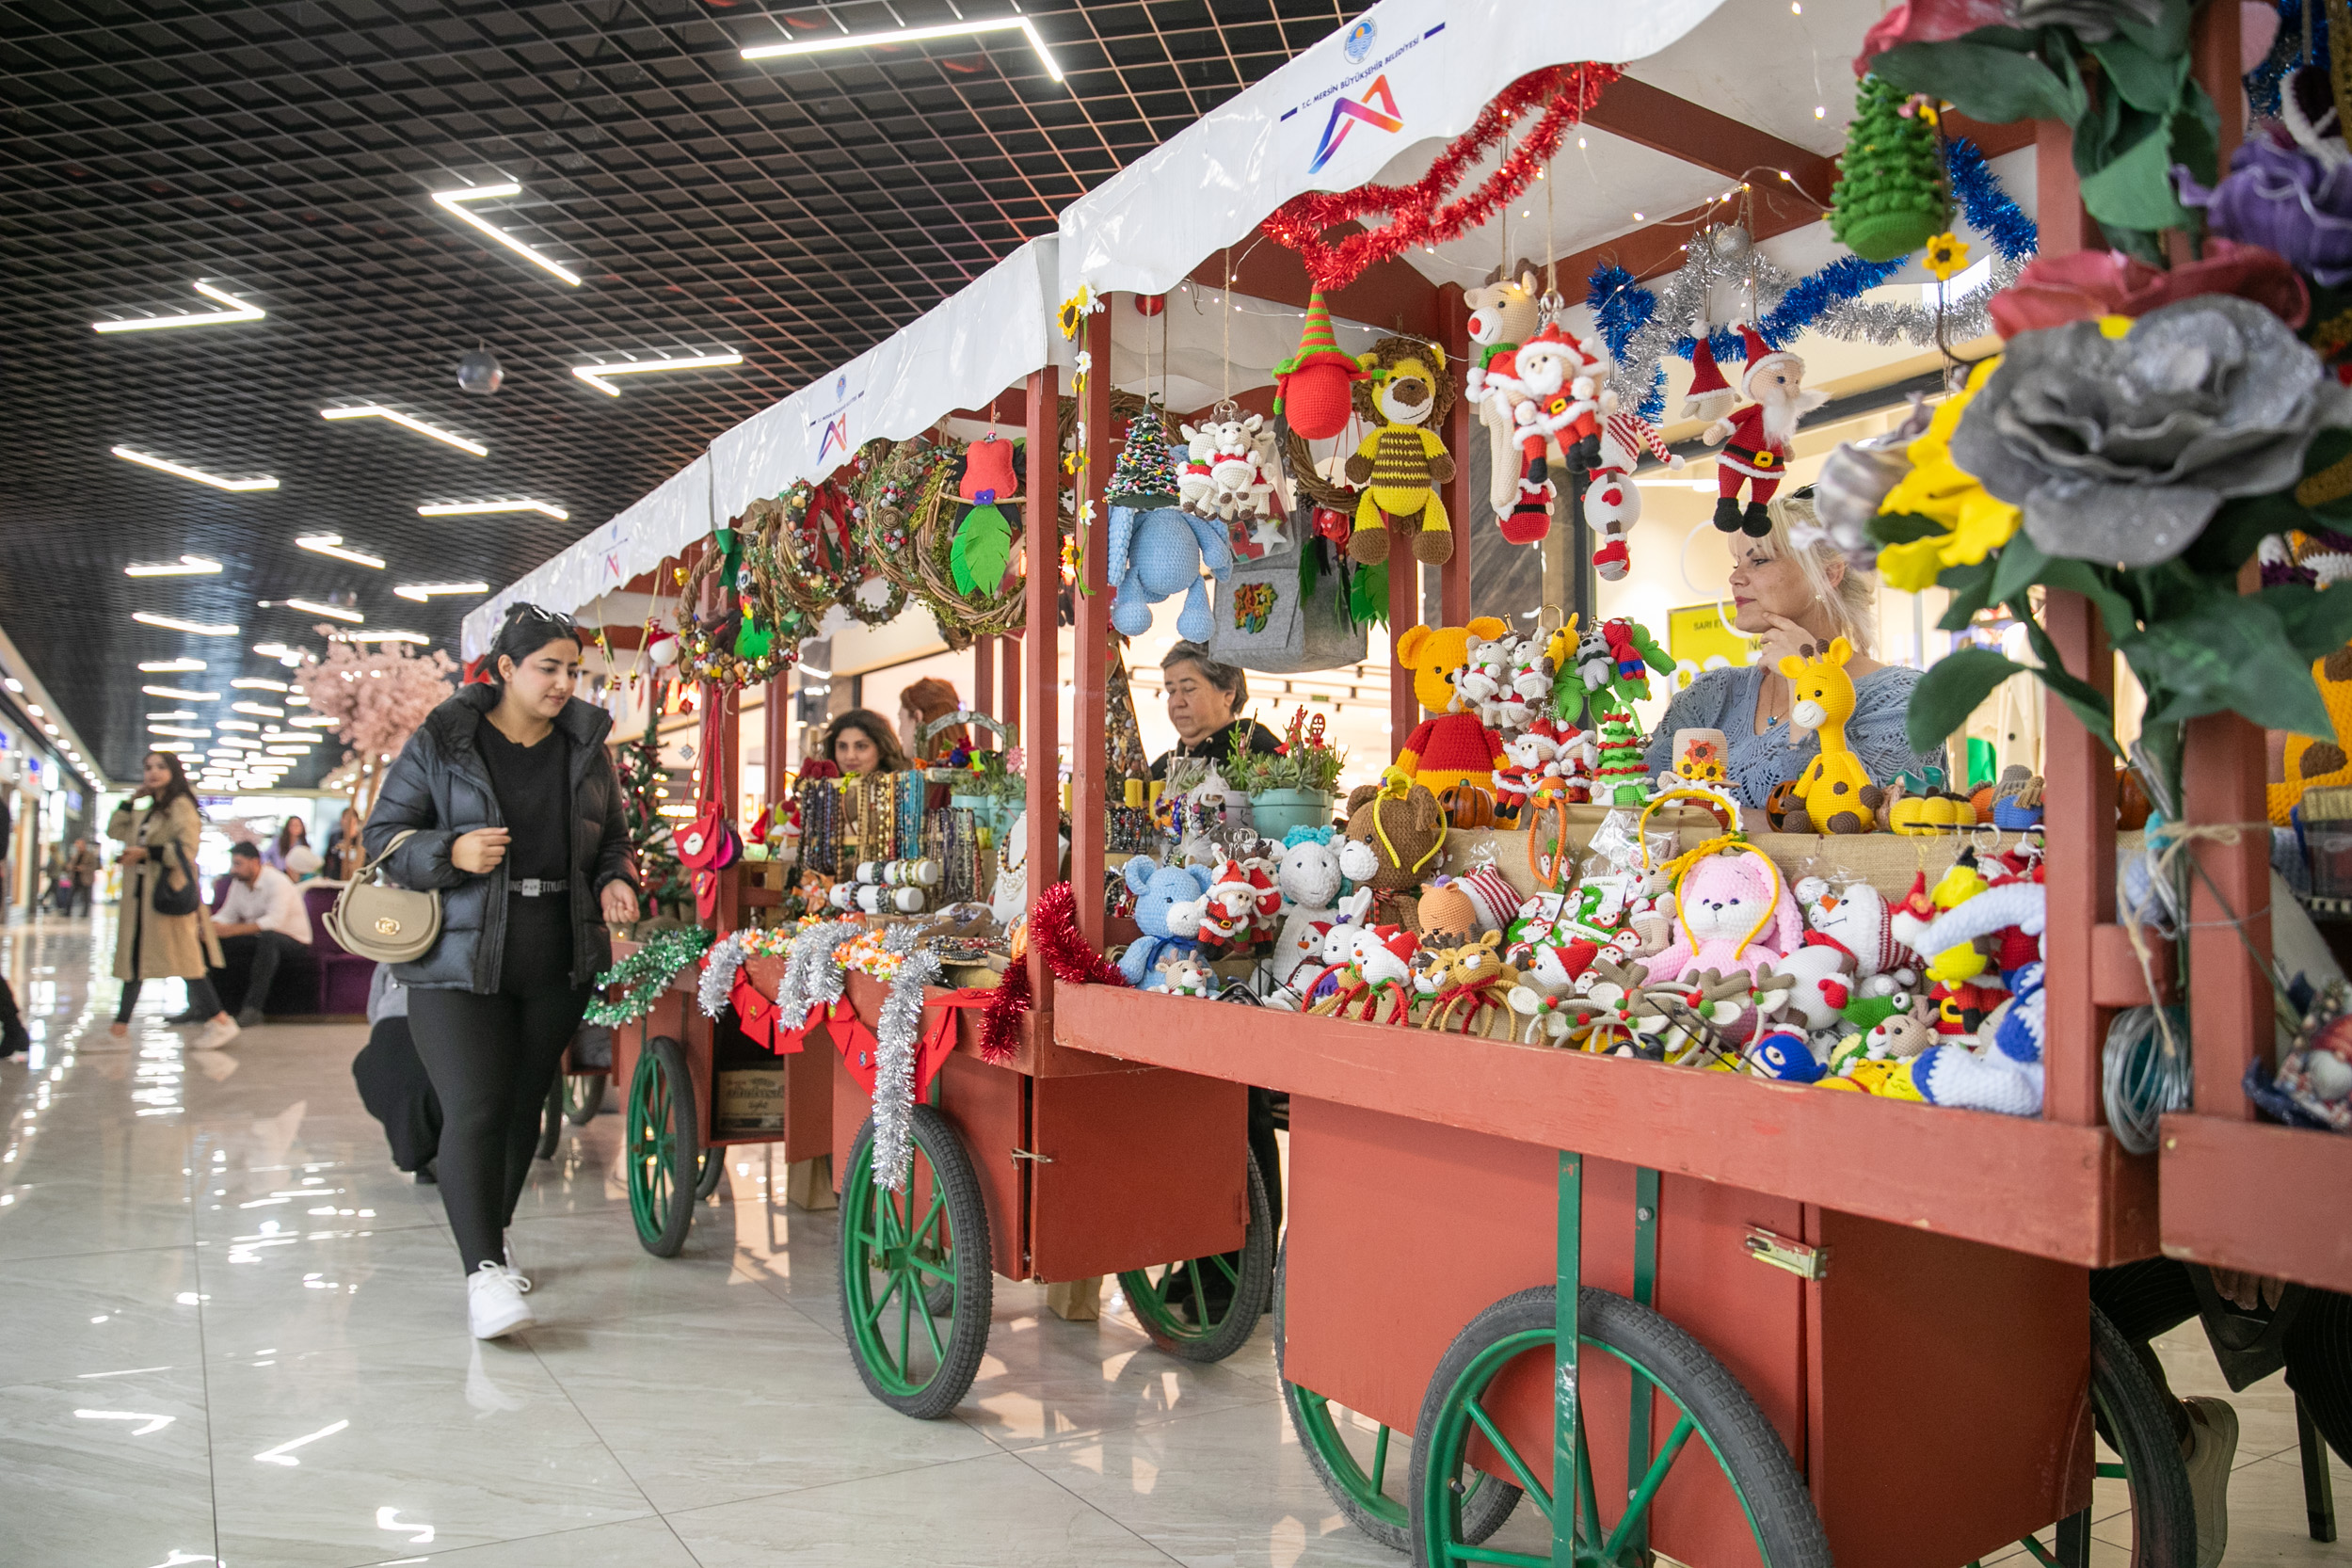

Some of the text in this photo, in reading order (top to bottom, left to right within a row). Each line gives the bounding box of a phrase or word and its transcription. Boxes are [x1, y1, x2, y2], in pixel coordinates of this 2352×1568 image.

[1302, 98, 1313, 110] T.C.
[1313, 84, 1338, 103] MERSİN
[1340, 60, 1383, 90] BÜYÜKŞEHİR
[1384, 34, 1419, 65] BELEDİYESİ
